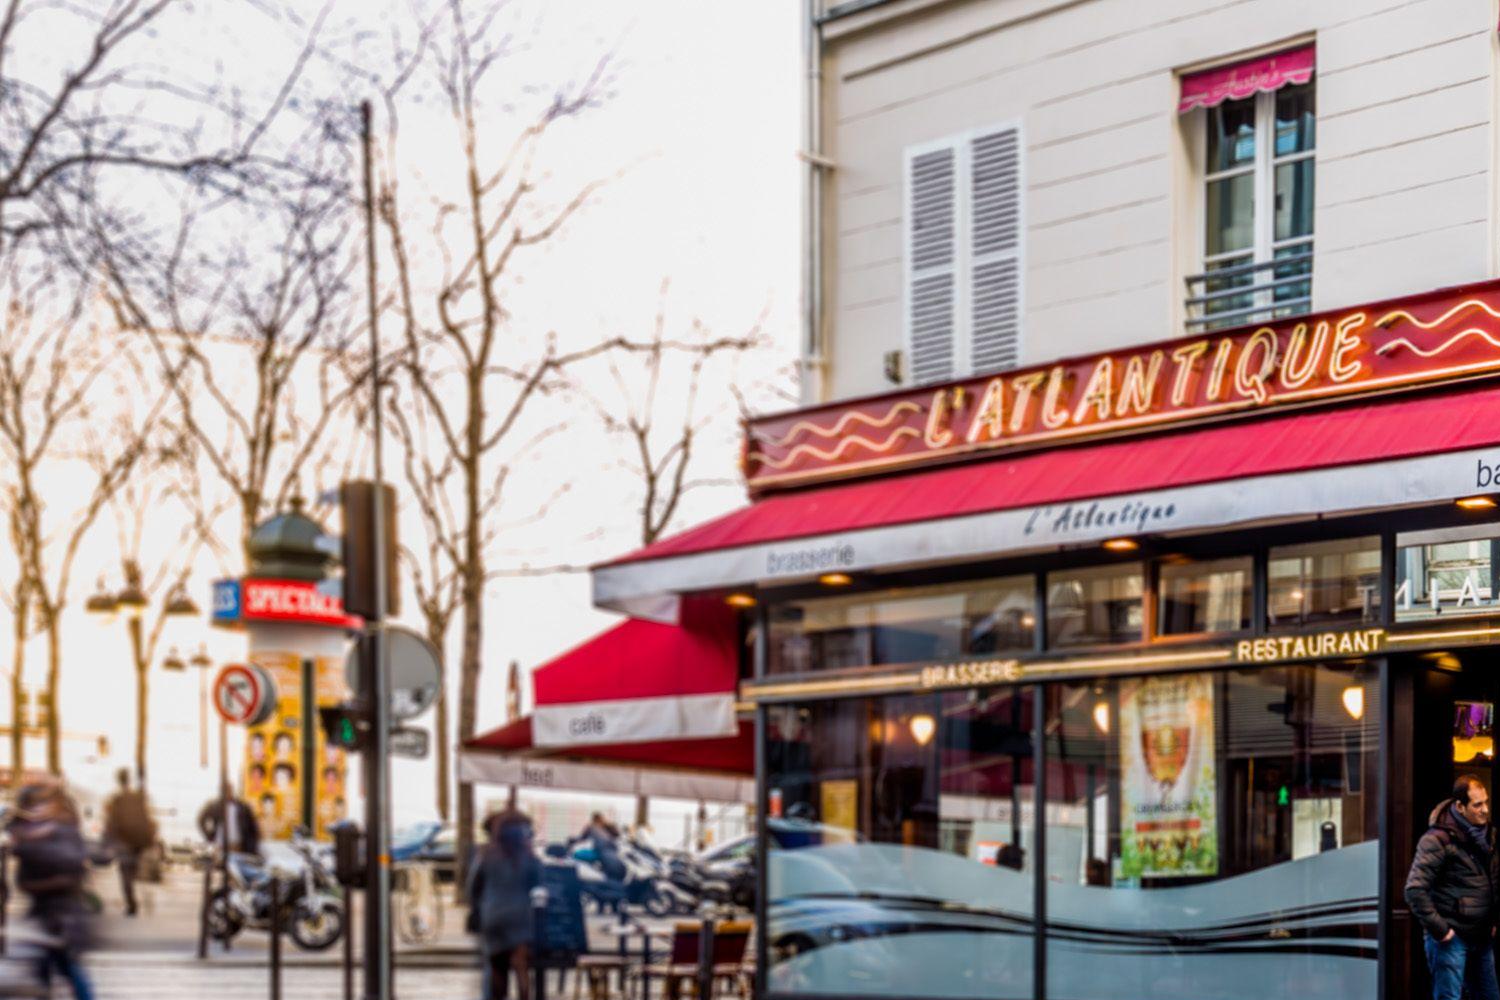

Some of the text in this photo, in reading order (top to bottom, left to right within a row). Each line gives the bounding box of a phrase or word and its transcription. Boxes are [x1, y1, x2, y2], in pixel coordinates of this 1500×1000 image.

[924, 311, 1367, 450] L'ATLANTIQUE
[766, 542, 855, 574] brasserie
[1238, 629, 1385, 661] RESTAURANT
[922, 660, 1023, 687] BRASSERIE
